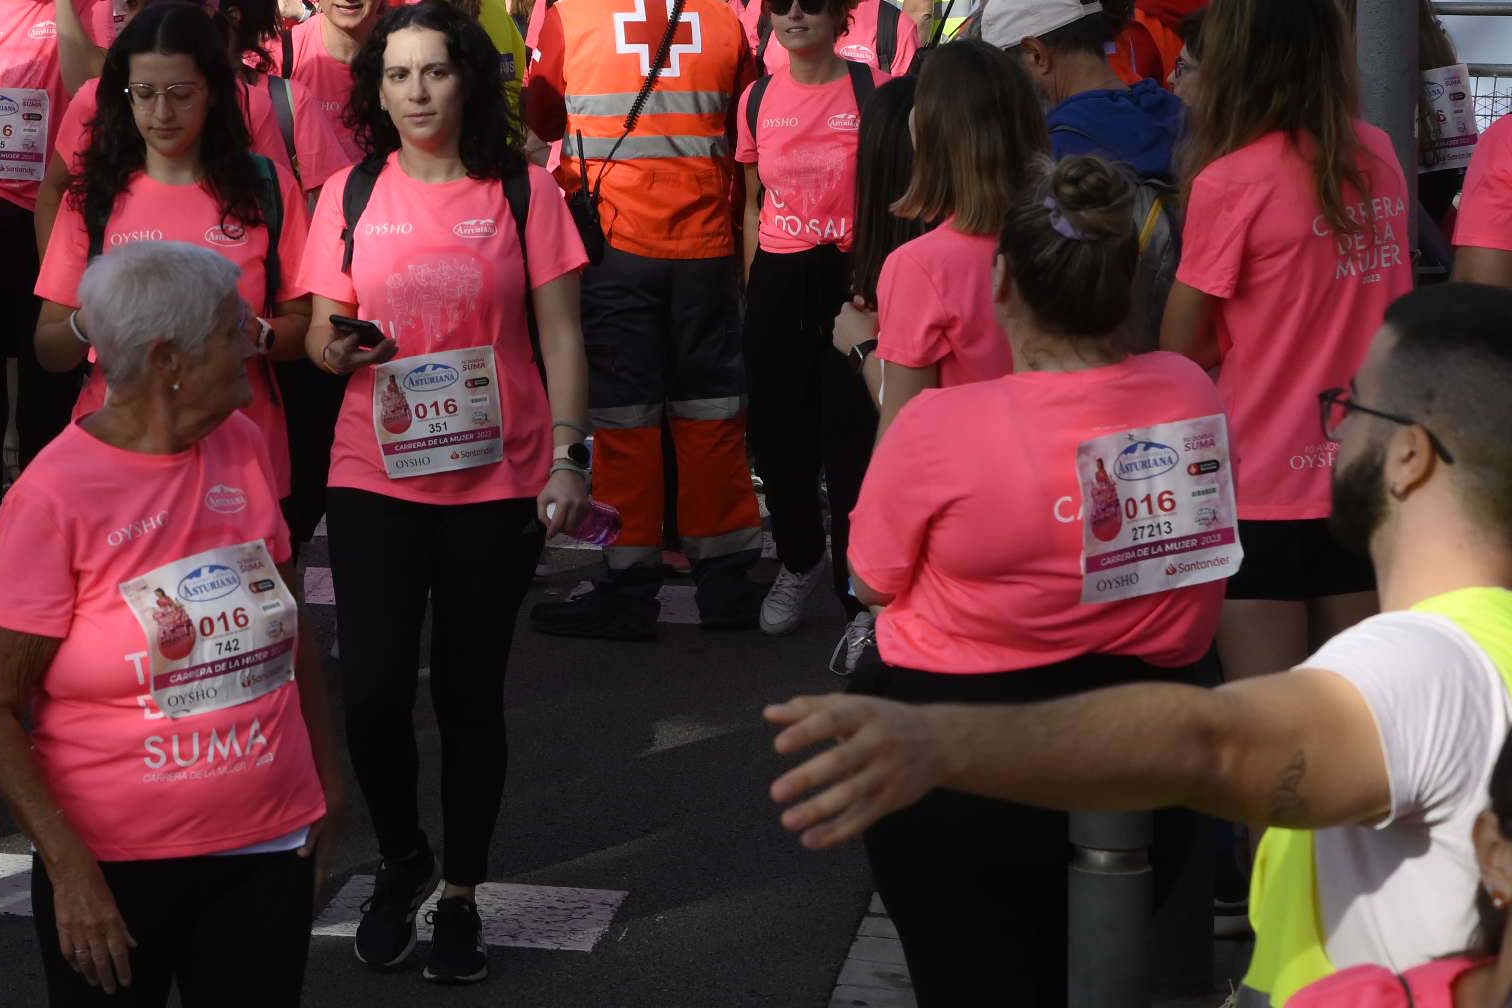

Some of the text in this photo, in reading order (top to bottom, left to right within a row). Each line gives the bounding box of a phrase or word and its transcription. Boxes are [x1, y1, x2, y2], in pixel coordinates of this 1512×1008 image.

[763, 117, 799, 129] OYSHO
[110, 229, 163, 246] OYSHO
[365, 222, 413, 235] OYSHO
[1335, 244, 1402, 279] MUJER
[462, 361, 486, 372] SUMA
[407, 373, 456, 390] ASTURIANA
[414, 397, 458, 420] 016
[428, 422, 448, 434] 351
[394, 440, 427, 452] CARRERA
[428, 439, 438, 448] DE
[439, 437, 448, 446] LA
[449, 433, 475, 445] MUJER
[1183, 438, 1217, 452] SUMA
[395, 455, 431, 470] OYSHO
[1118, 454, 1174, 475] ASTURIANA
[1124, 489, 1177, 519] 016
[1131, 521, 1173, 541] 27213
[1100, 533, 1222, 567] CARRERA DE LA MUJER 2023
[1178, 555, 1230, 575] Santander
[184, 573, 238, 599] ASTURIANA
[1095, 573, 1140, 593] OYSHO
[199, 606, 250, 637] 016
[215, 638, 241, 656] 742
[169, 666, 214, 684] CARRERA
[215, 661, 230, 674] DE
[230, 658, 241, 671] LA
[167, 686, 218, 709] OYSHO
[143, 718, 268, 769] SUMA
